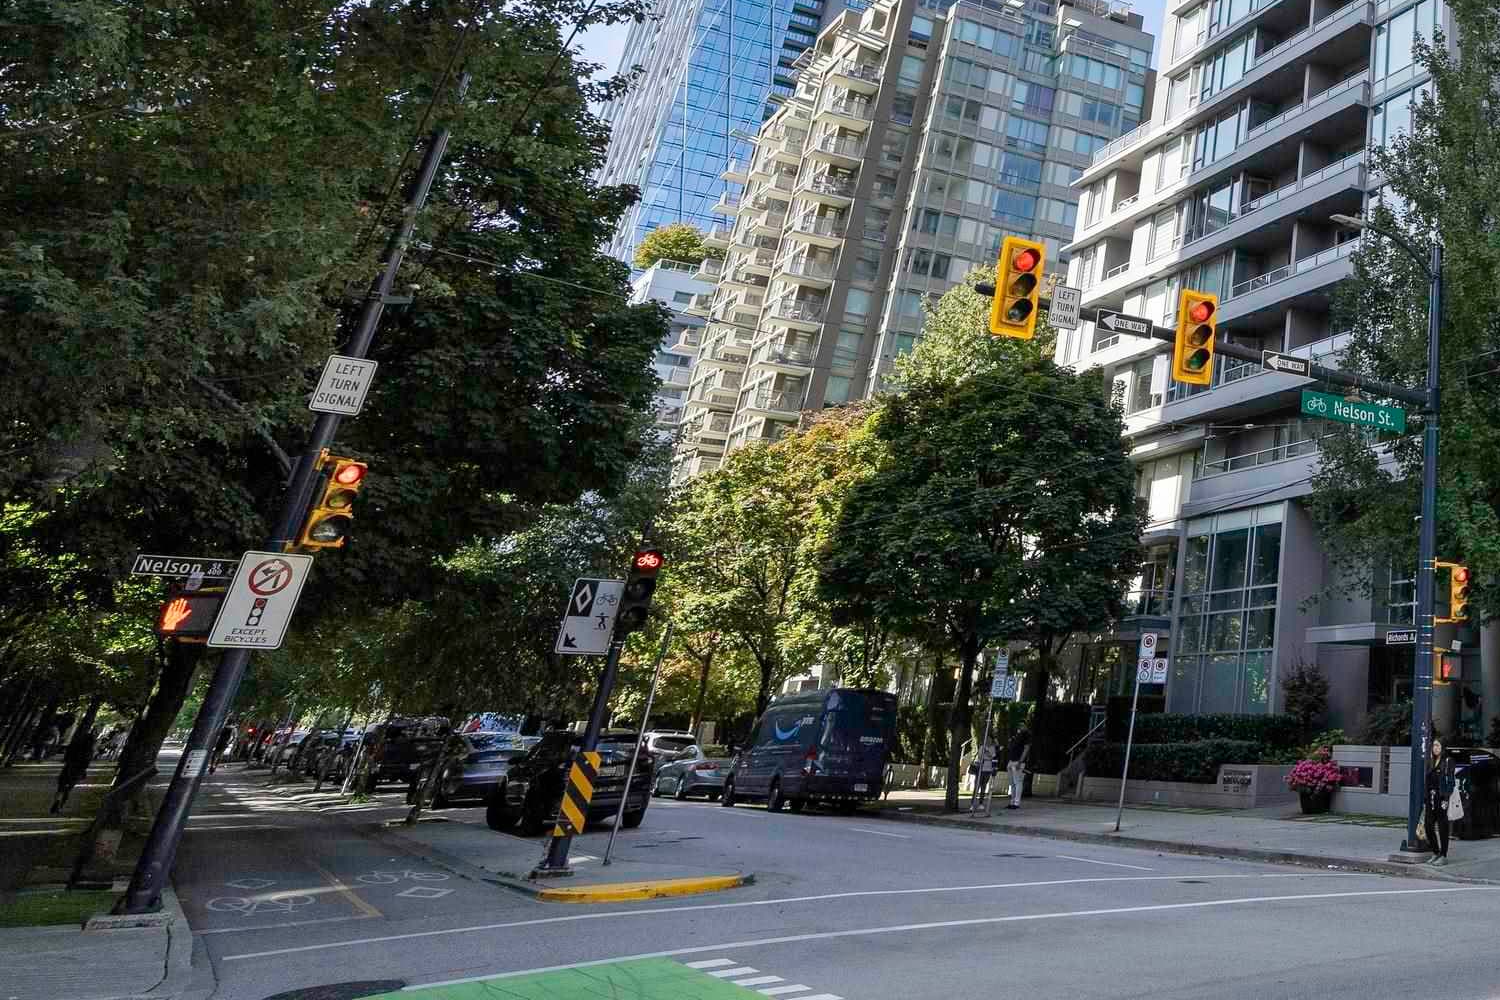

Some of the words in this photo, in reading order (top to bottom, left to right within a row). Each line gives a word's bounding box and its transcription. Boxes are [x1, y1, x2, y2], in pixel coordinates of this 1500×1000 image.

[1058, 290, 1075, 301] LEFT
[1056, 301, 1075, 313] TURN
[1051, 312, 1075, 325] SIGNAL
[1114, 318, 1129, 329] ONE
[1131, 321, 1146, 332] WAY
[336, 363, 366, 377] LEFT
[1277, 358, 1289, 368] ONE
[1291, 360, 1305, 371] WAY
[329, 377, 361, 392] TURN
[316, 392, 358, 408] SIGNAL
[1334, 401, 1375, 422] Nelson
[1378, 410, 1395, 427] St.
[139, 559, 203, 574] Nelson
[224, 635, 267, 644] BICYCLES
